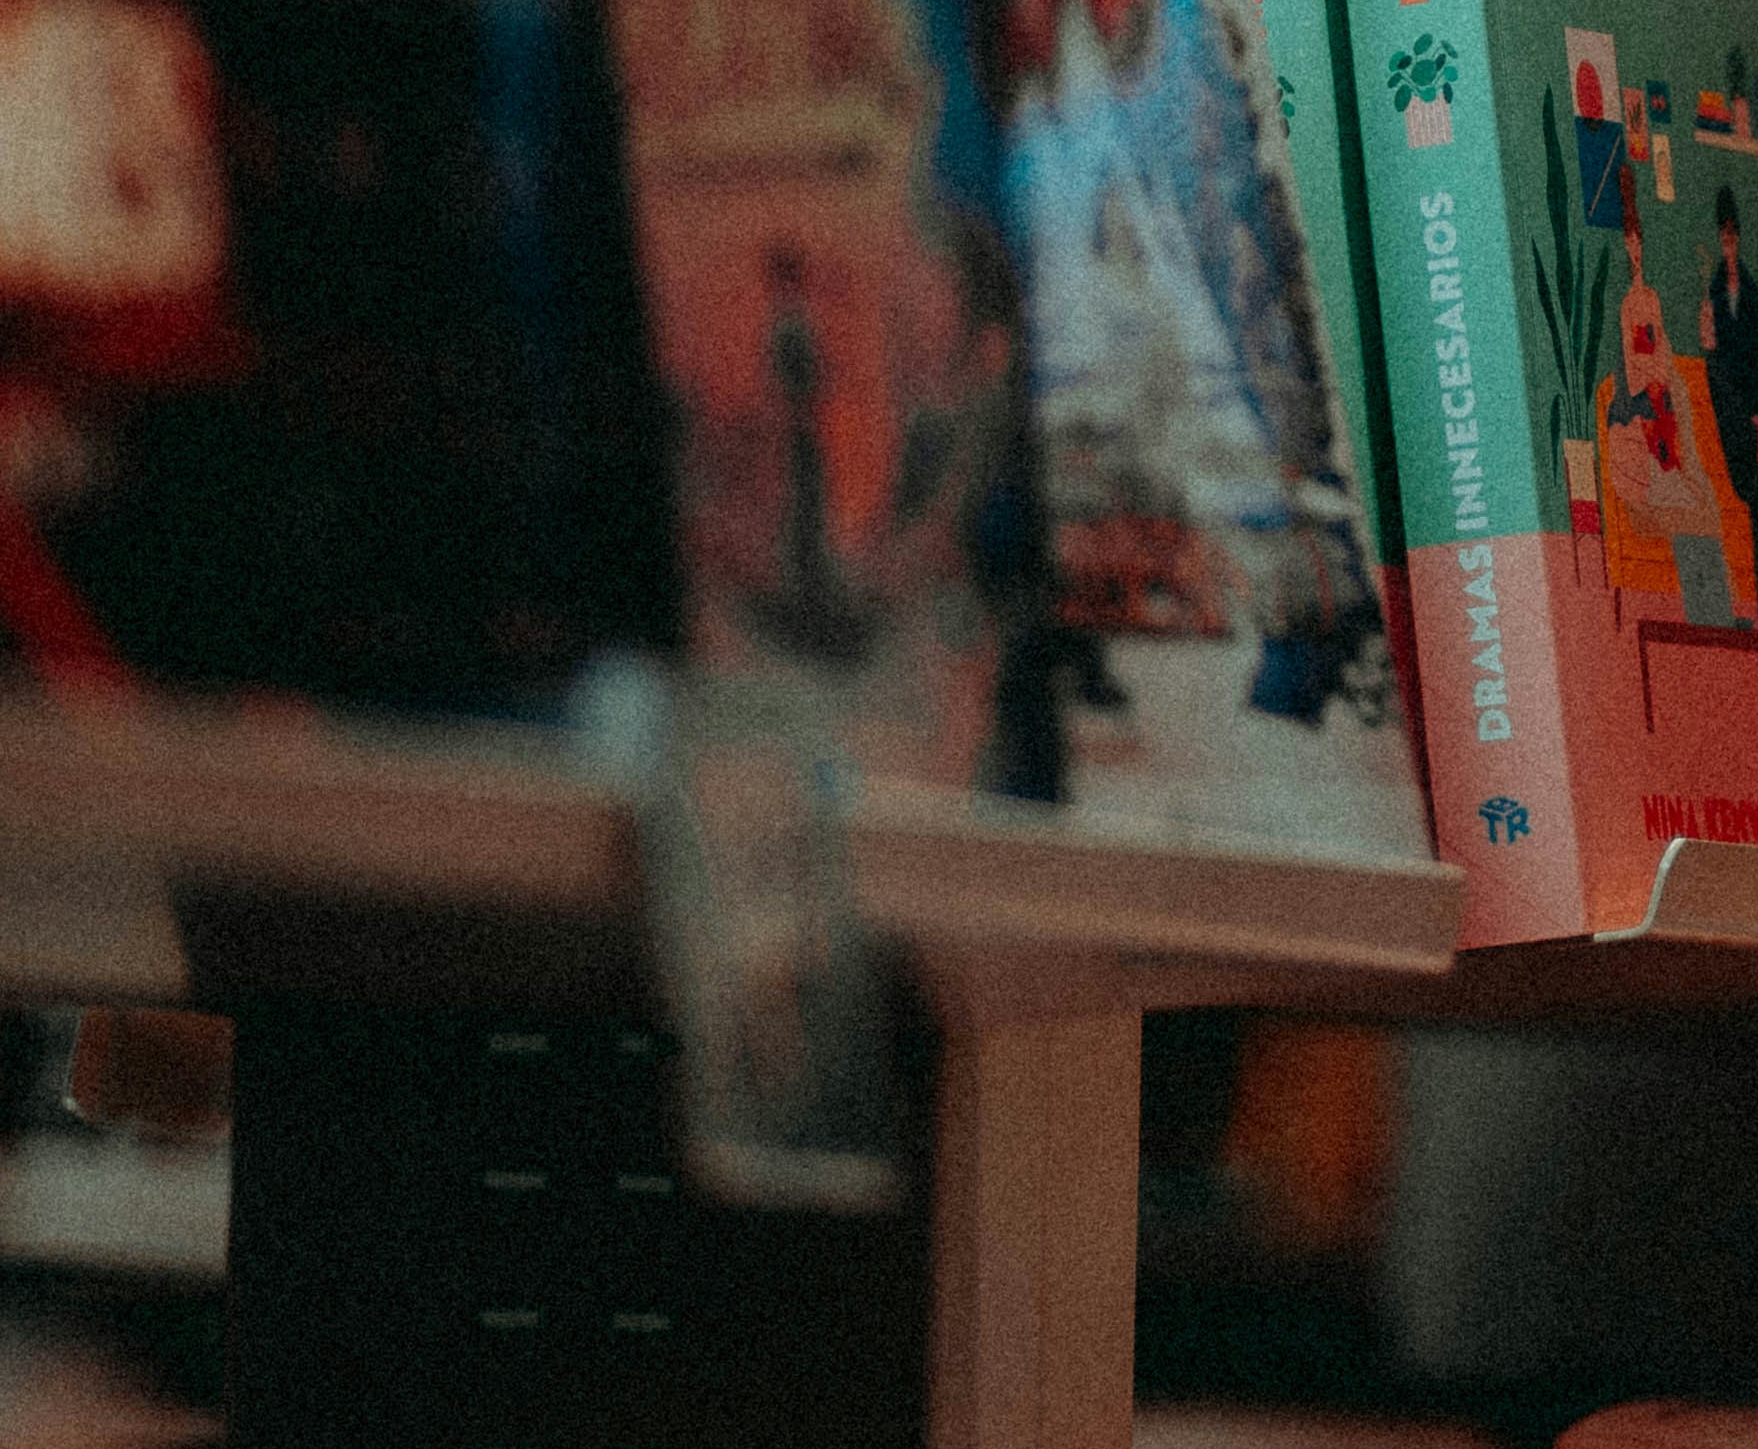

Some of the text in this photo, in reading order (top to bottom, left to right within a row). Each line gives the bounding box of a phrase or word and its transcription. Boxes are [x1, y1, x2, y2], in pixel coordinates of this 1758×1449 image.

[1421, 190, 1514, 743] DRAMAS INNECESARIOS
[1642, 794, 1700, 841] NINA
